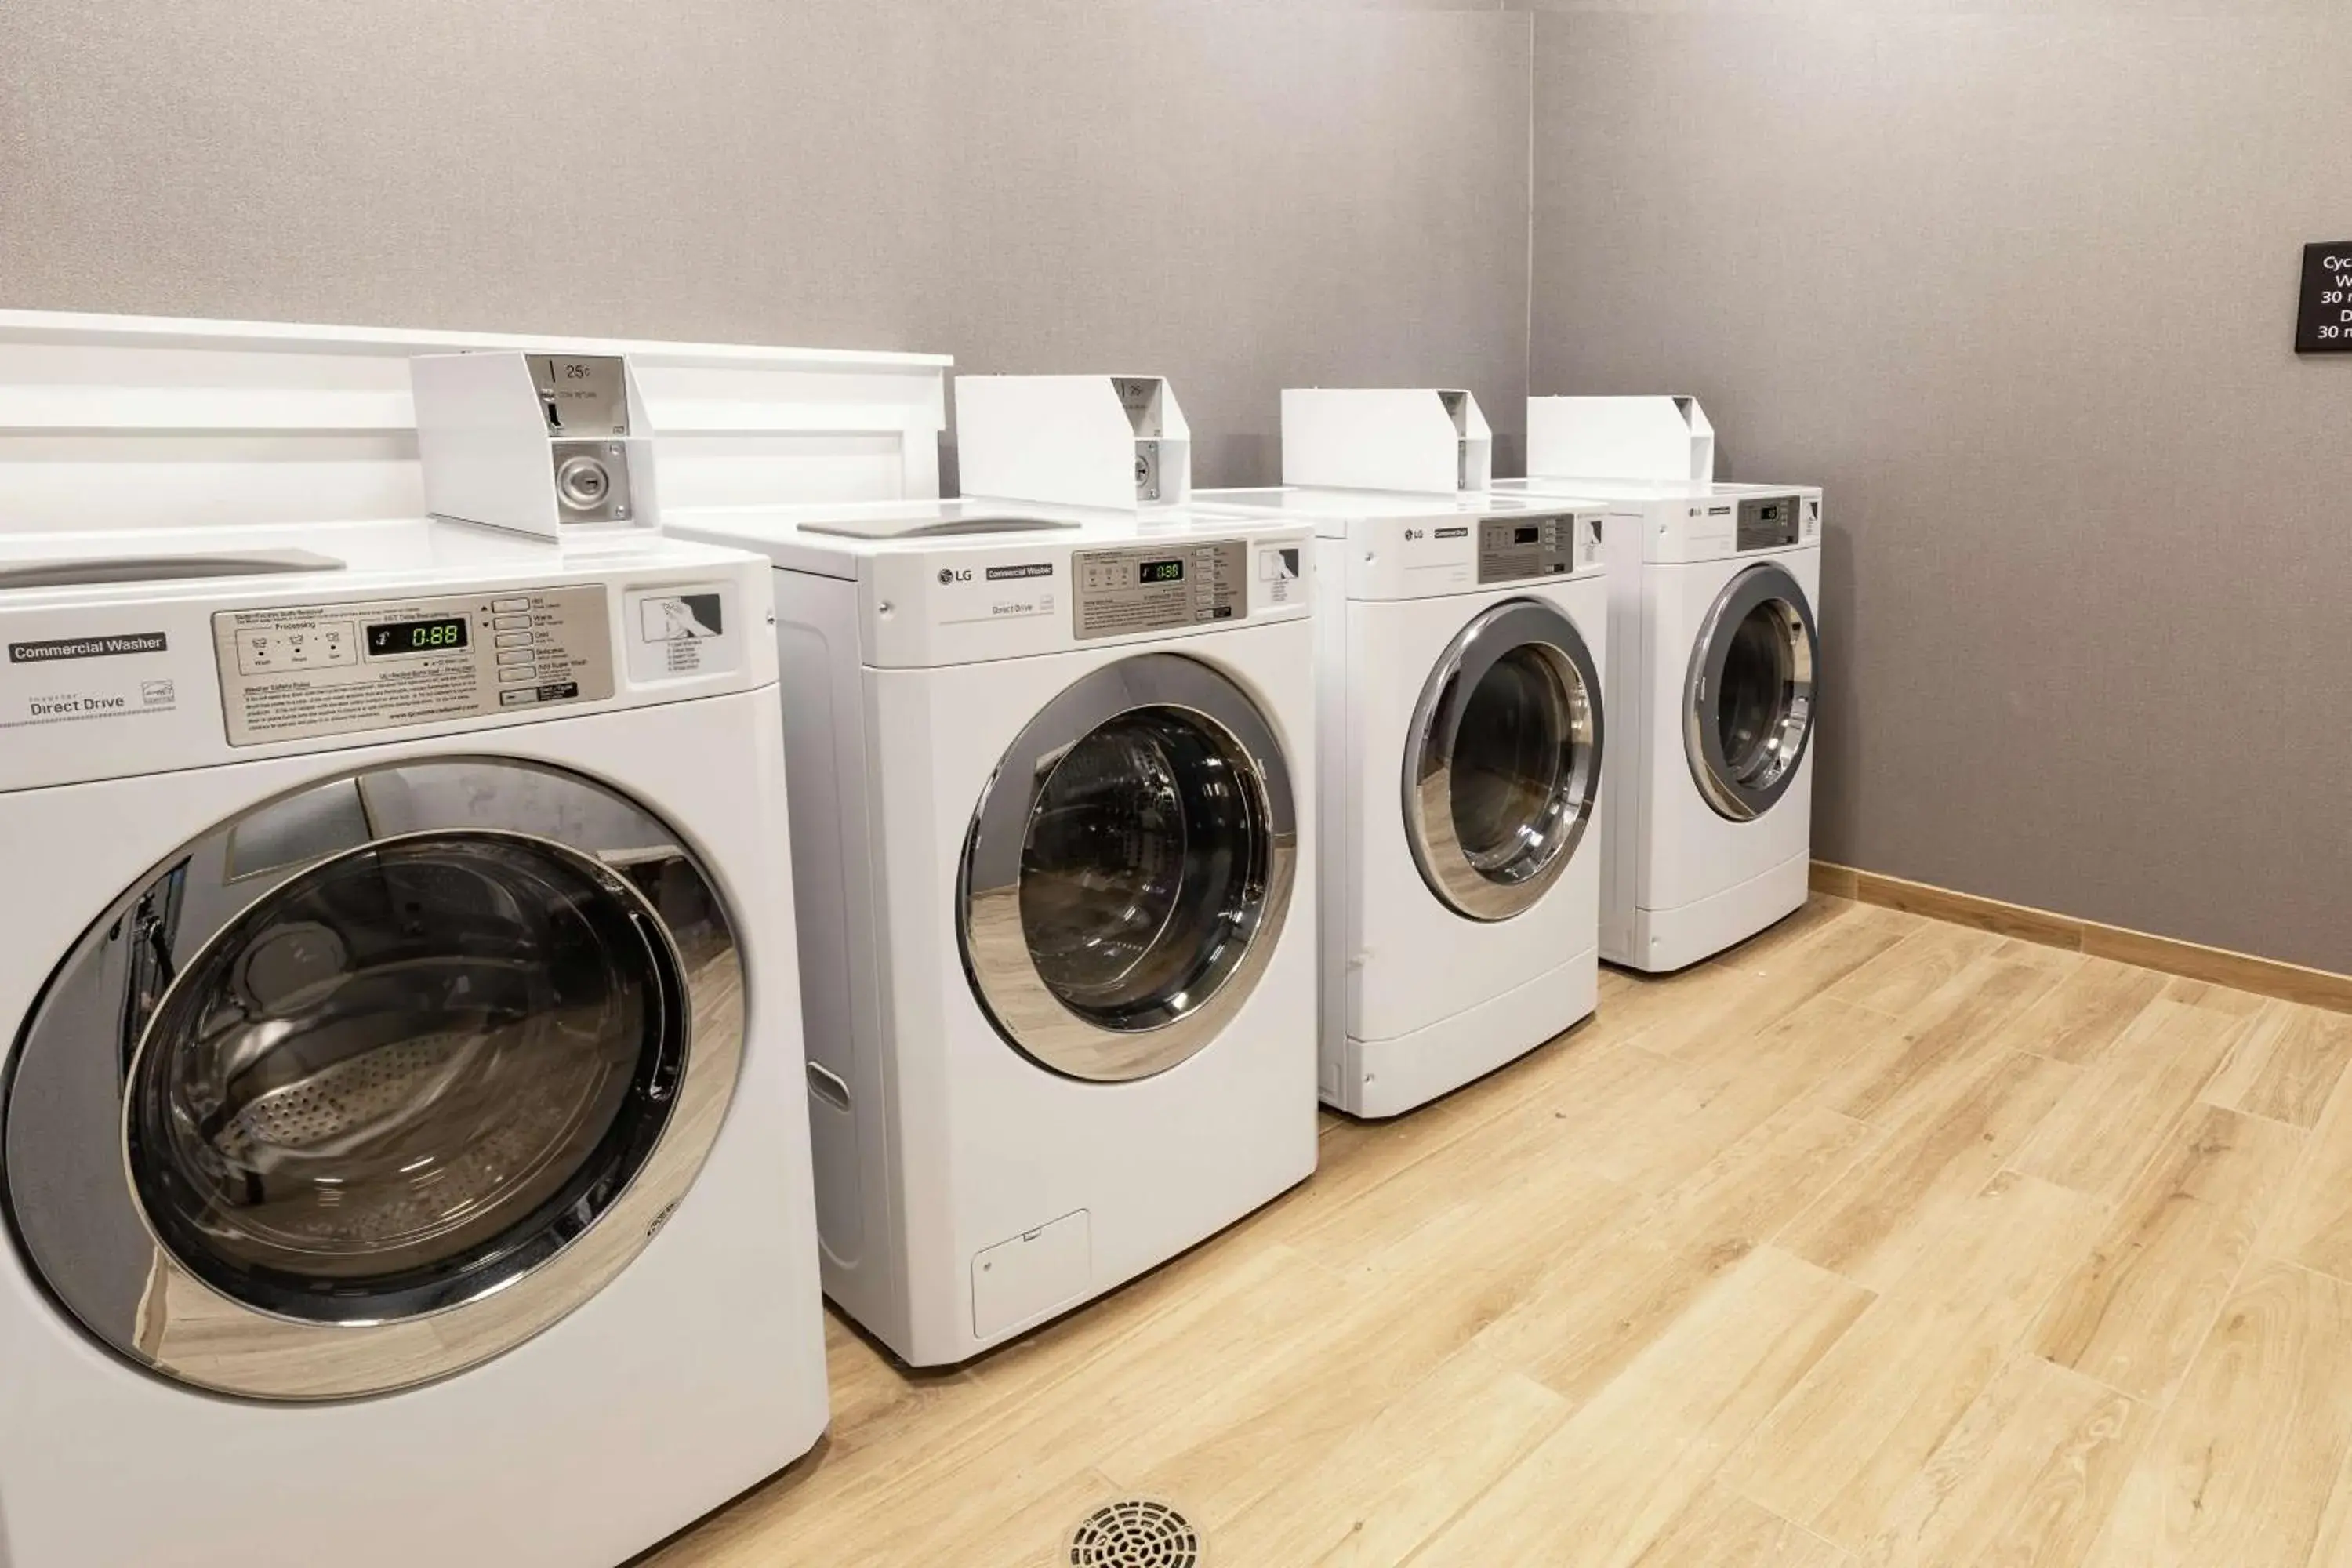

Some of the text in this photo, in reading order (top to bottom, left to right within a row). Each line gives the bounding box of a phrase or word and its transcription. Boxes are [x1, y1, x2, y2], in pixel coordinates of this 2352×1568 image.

[2321, 291, 2343, 303] 30
[2318, 326, 2339, 339] 30
[956, 570, 971, 581] LG
[989, 568, 1025, 579] Commercial
[1015, 603, 1033, 612] Drive
[275, 621, 316, 630] Processing
[15, 637, 162, 659] Commercial Washer
[31, 696, 125, 717] Direct Drive
